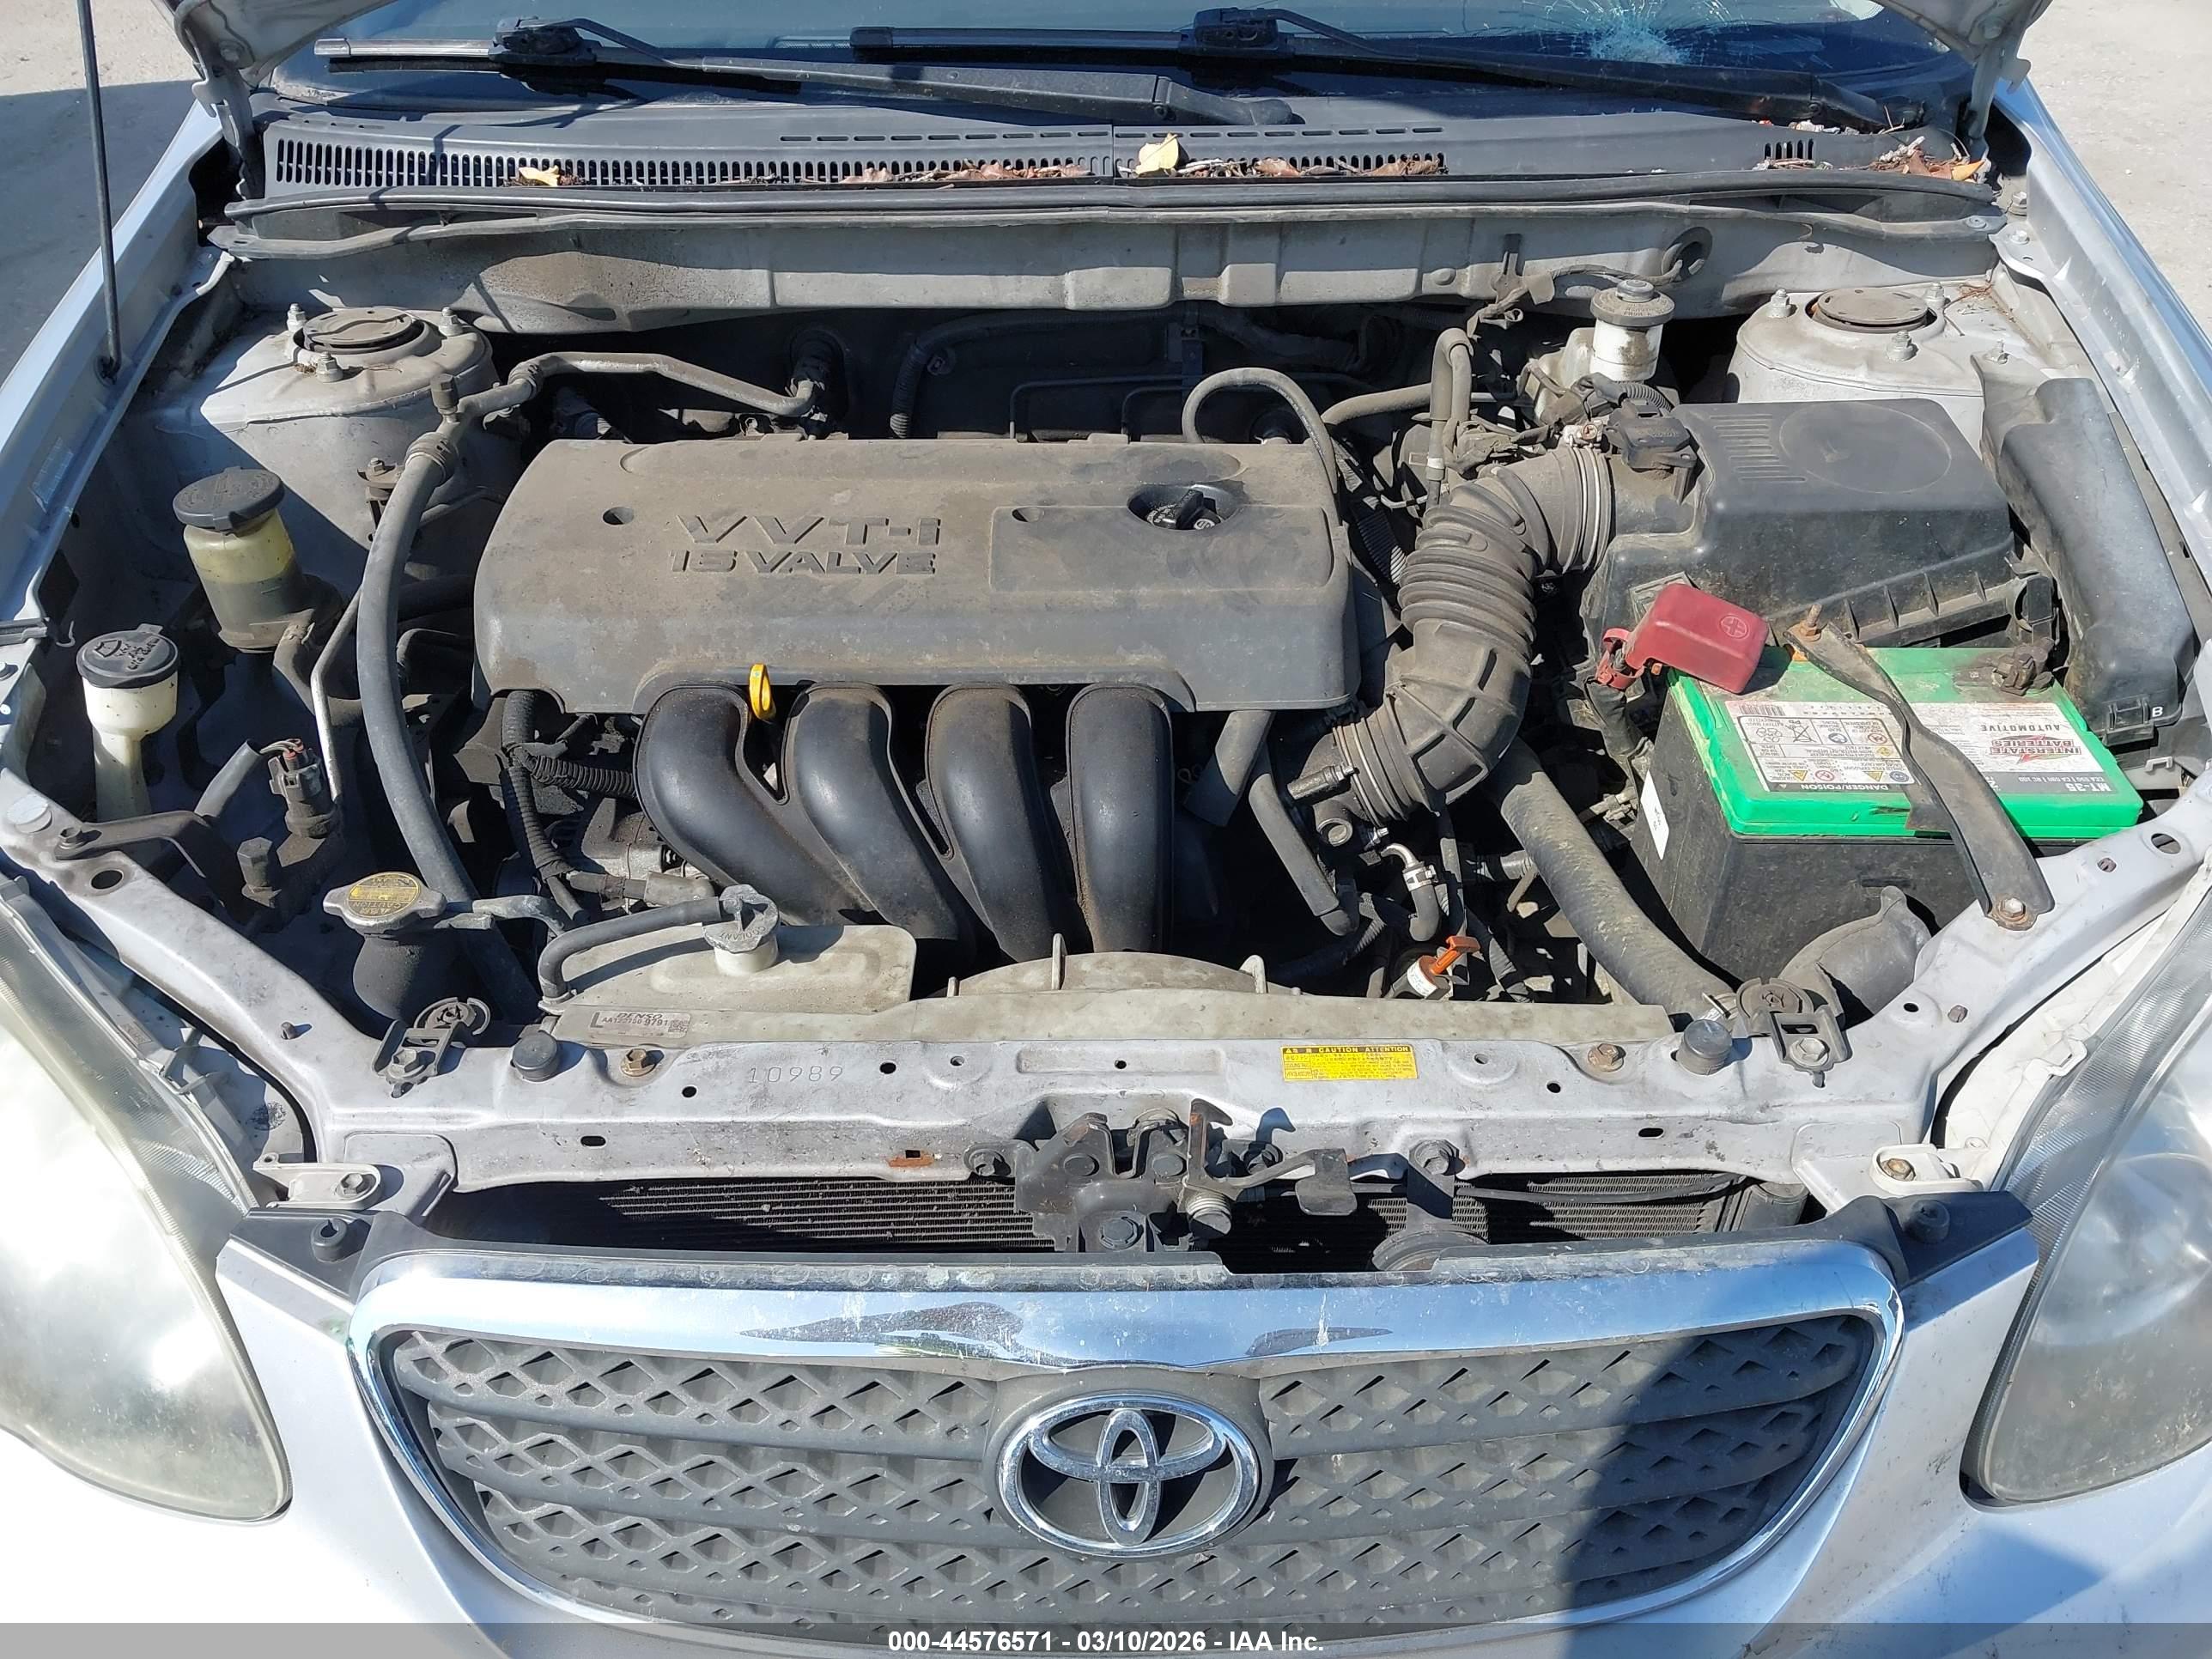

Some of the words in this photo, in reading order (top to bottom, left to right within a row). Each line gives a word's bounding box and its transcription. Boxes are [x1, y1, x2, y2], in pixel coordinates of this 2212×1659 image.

[669, 550, 738, 574] 16
[744, 550, 937, 575] VALVE
[2152, 706, 2164, 718] B
[1991, 739, 2074, 748] BATTERIES
[1989, 746, 2081, 755] INTERSTATE
[2064, 782, 2112, 792] MT-35
[720, 926, 766, 940] COOLANT
[748, 1065, 844, 1084] 10989
